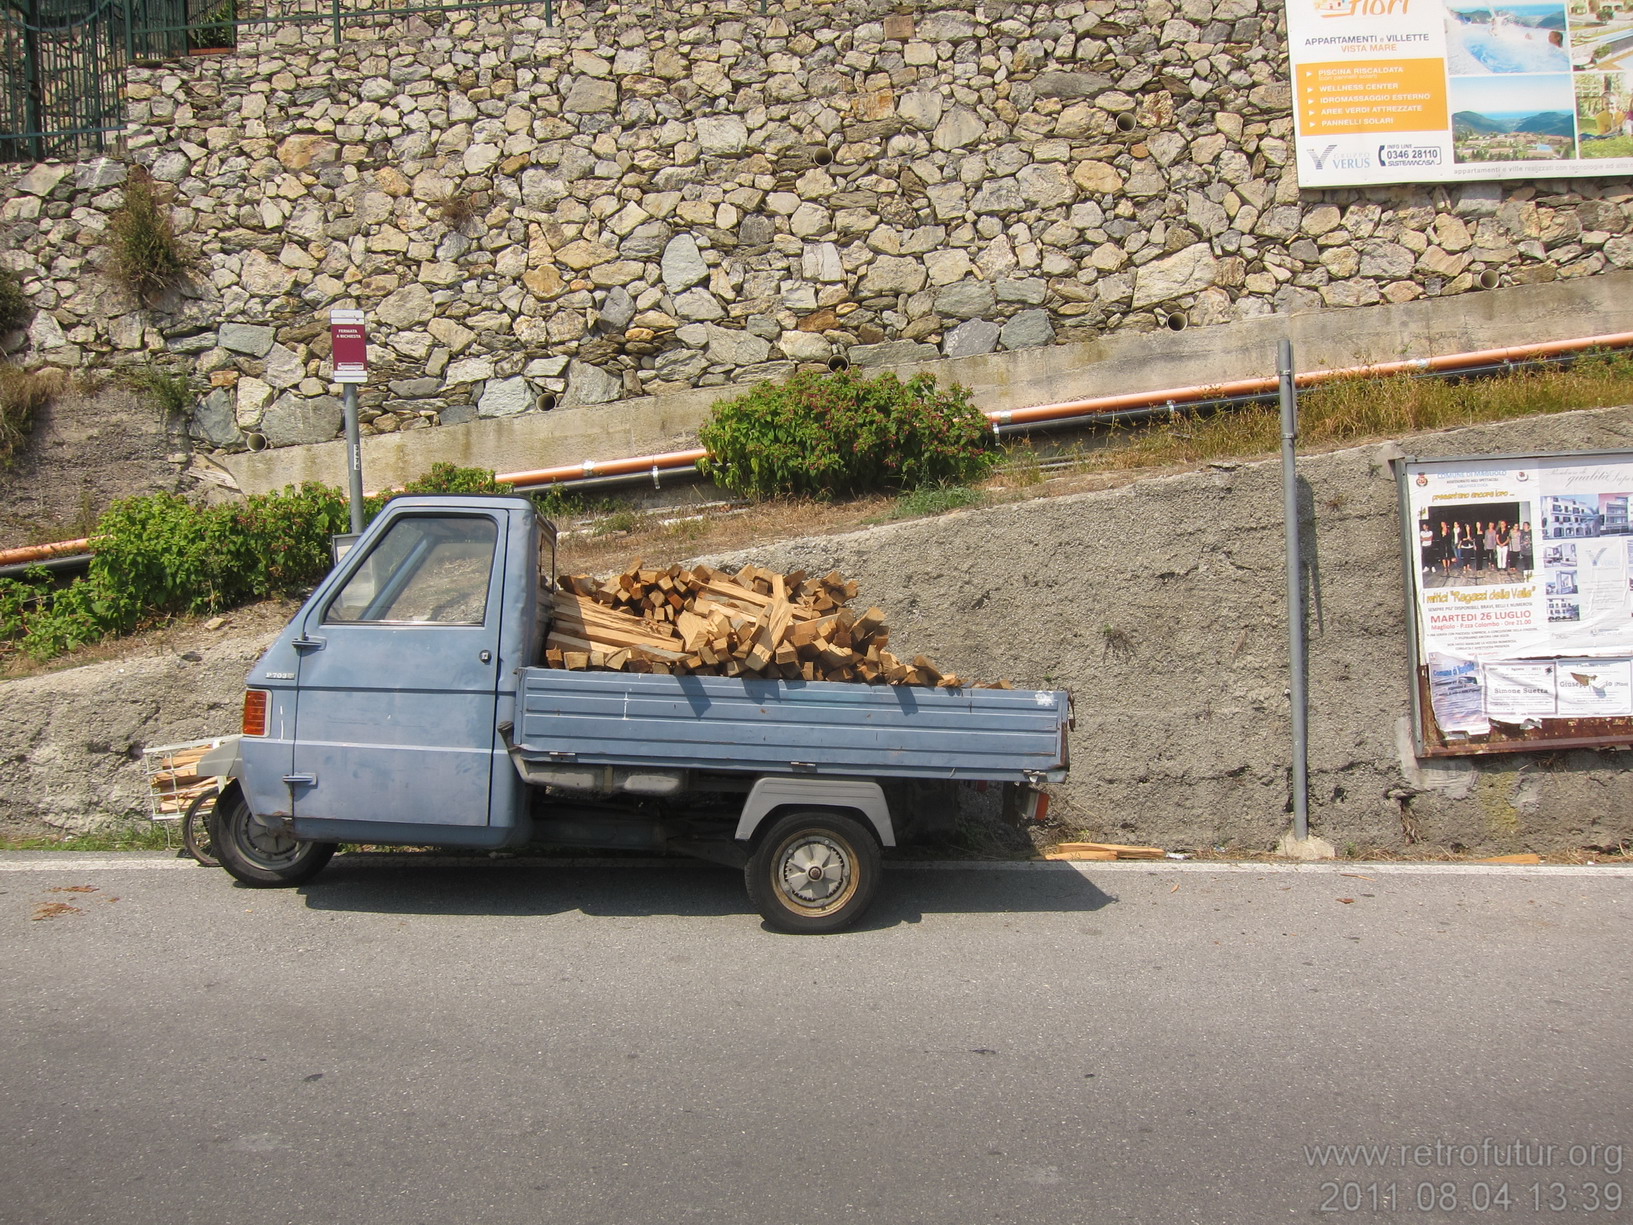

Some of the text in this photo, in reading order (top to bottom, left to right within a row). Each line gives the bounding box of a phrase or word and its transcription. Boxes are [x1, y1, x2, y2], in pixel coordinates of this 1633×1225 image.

[1305, 35, 1377, 46] APPARTAMENTI
[1386, 34, 1429, 42] VILLETTE
[1341, 45, 1367, 53] VISTA
[1354, 66, 1403, 75] RISCALDATA
[1320, 95, 1390, 104] IDROMASSAGGIO
[1321, 105, 1423, 116] AREE VERDI ATTREZZATE
[1321, 117, 1394, 127] PANNELLI SOLARI
[1386, 149, 1438, 160] 0346 28110
[1333, 158, 1370, 169] VERUS
[1430, 610, 1532, 623] MARTEDI 26 LUGLIO
[1475, 621, 1500, 629] Colombo
